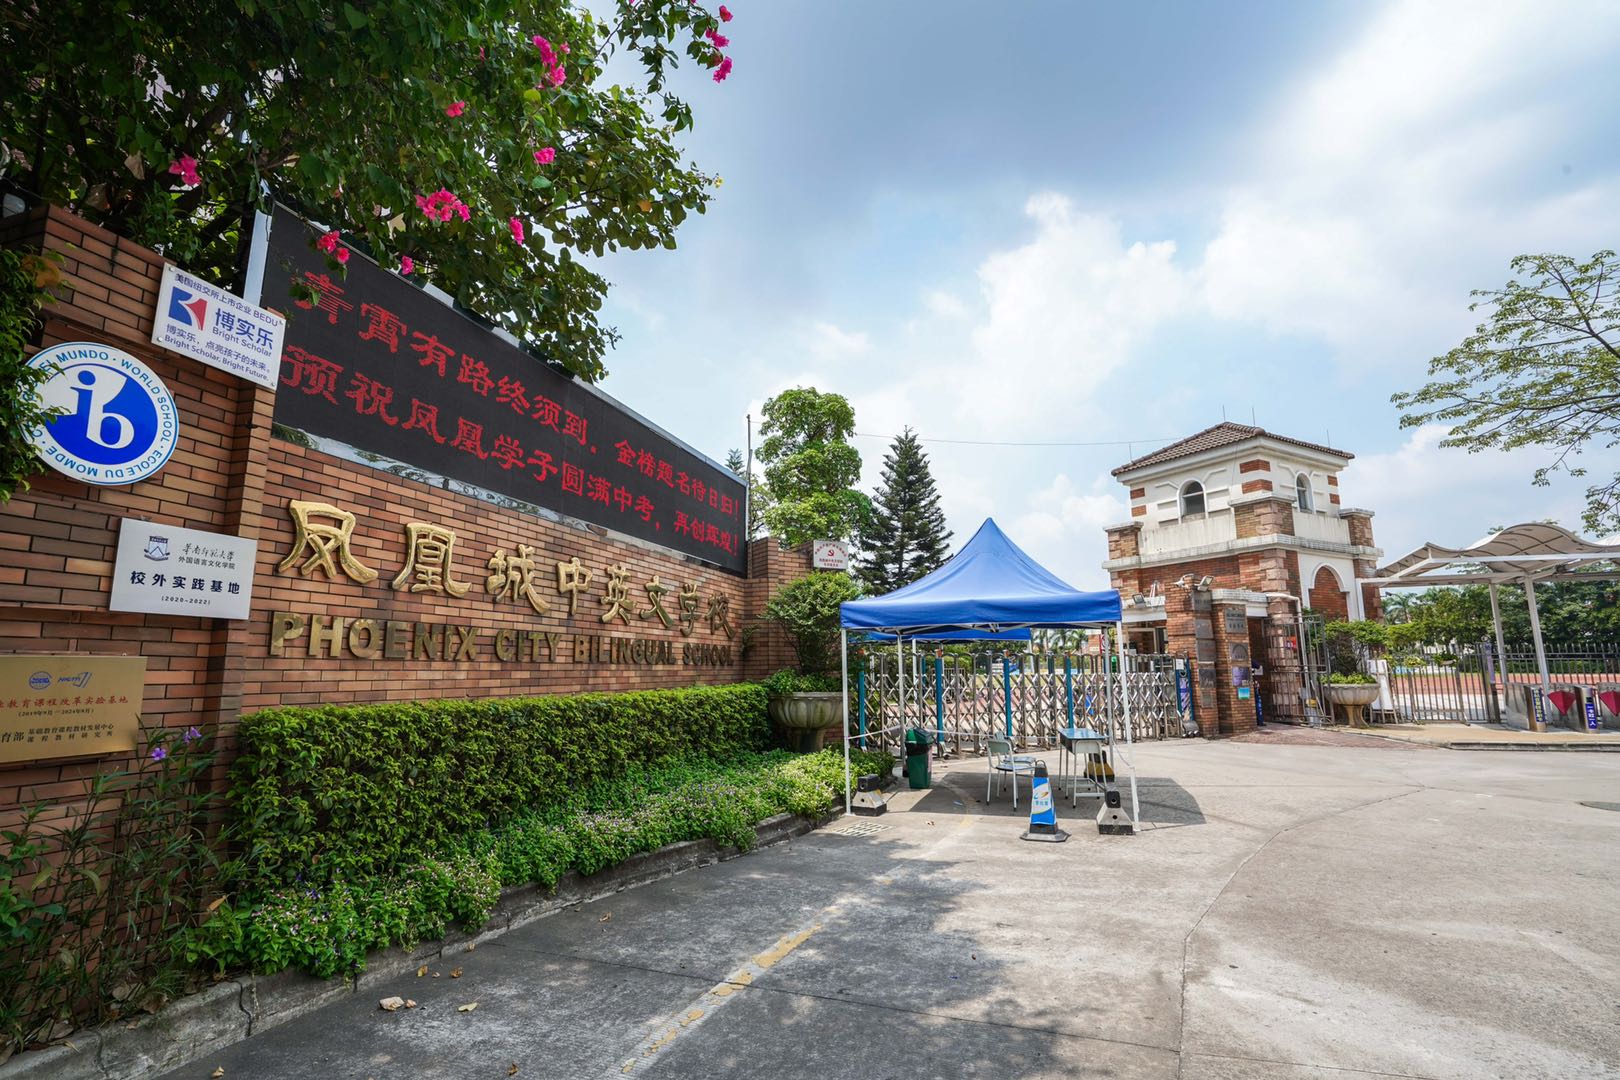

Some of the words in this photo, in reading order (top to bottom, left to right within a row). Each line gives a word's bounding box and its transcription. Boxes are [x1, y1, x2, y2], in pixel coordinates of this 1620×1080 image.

[215, 307, 273, 350] 博实乐
[253, 310, 279, 327] BEDU
[56, 349, 109, 363] MUNDO
[213, 327, 240, 344] Bright
[241, 339, 272, 357] Scholar
[164, 334, 190, 350] Bright
[222, 357, 245, 373] Bright
[245, 366, 270, 381] Future.
[120, 359, 161, 395] WORLD
[157, 396, 173, 443] SCHOOL
[105, 466, 124, 478] DU
[129, 449, 162, 477] ECOLE
[178, 555, 236, 570] 外国语言文化学院
[278, 499, 737, 639] 凤凰城中英文学校
[130, 571, 240, 595] 校外实践基地
[270, 611, 479, 661] PHOENIX
[495, 629, 562, 662] CITY
[574, 635, 676, 665] BILINGUAL
[683, 641, 734, 666] SCHOOL
